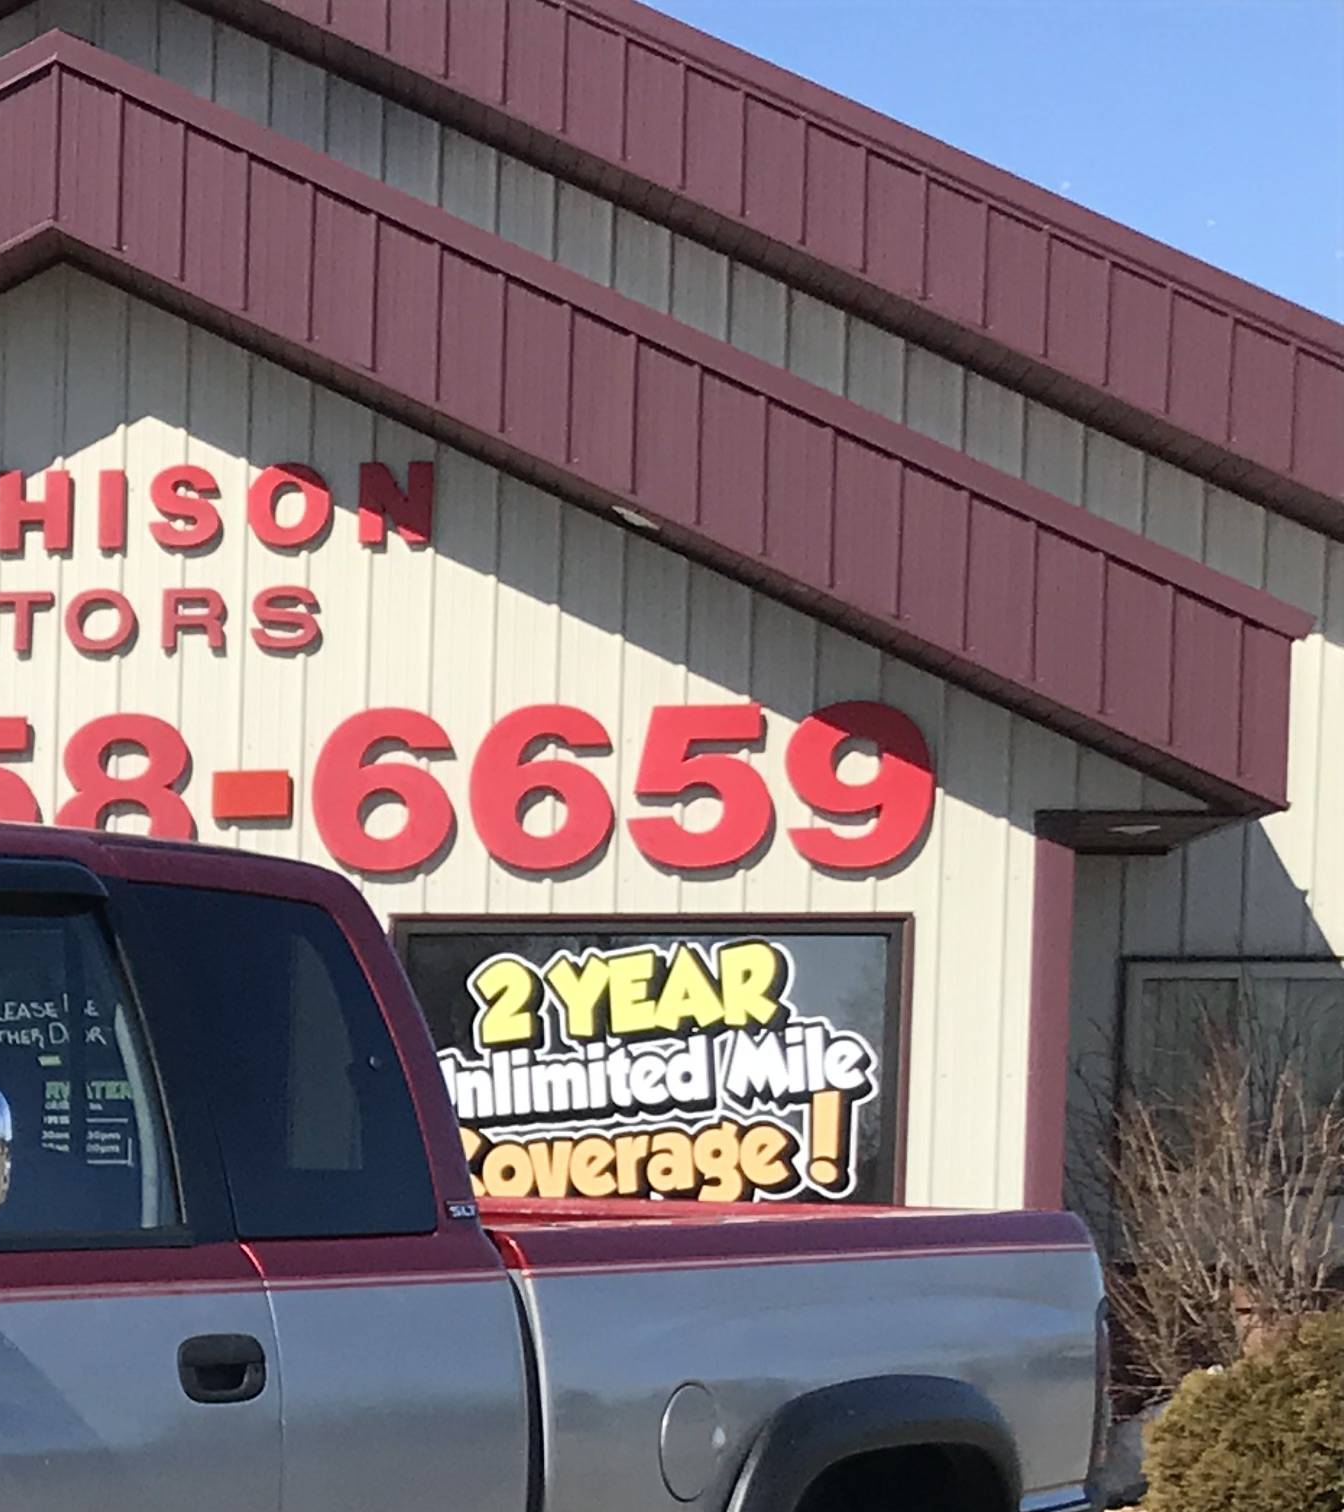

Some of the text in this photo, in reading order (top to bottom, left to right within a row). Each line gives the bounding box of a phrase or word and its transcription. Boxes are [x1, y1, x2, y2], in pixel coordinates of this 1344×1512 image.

[474, 940, 782, 1045] 2 YEAR
[725, 1025, 871, 1099] Mile
[448, 1204, 476, 1218] SLT
